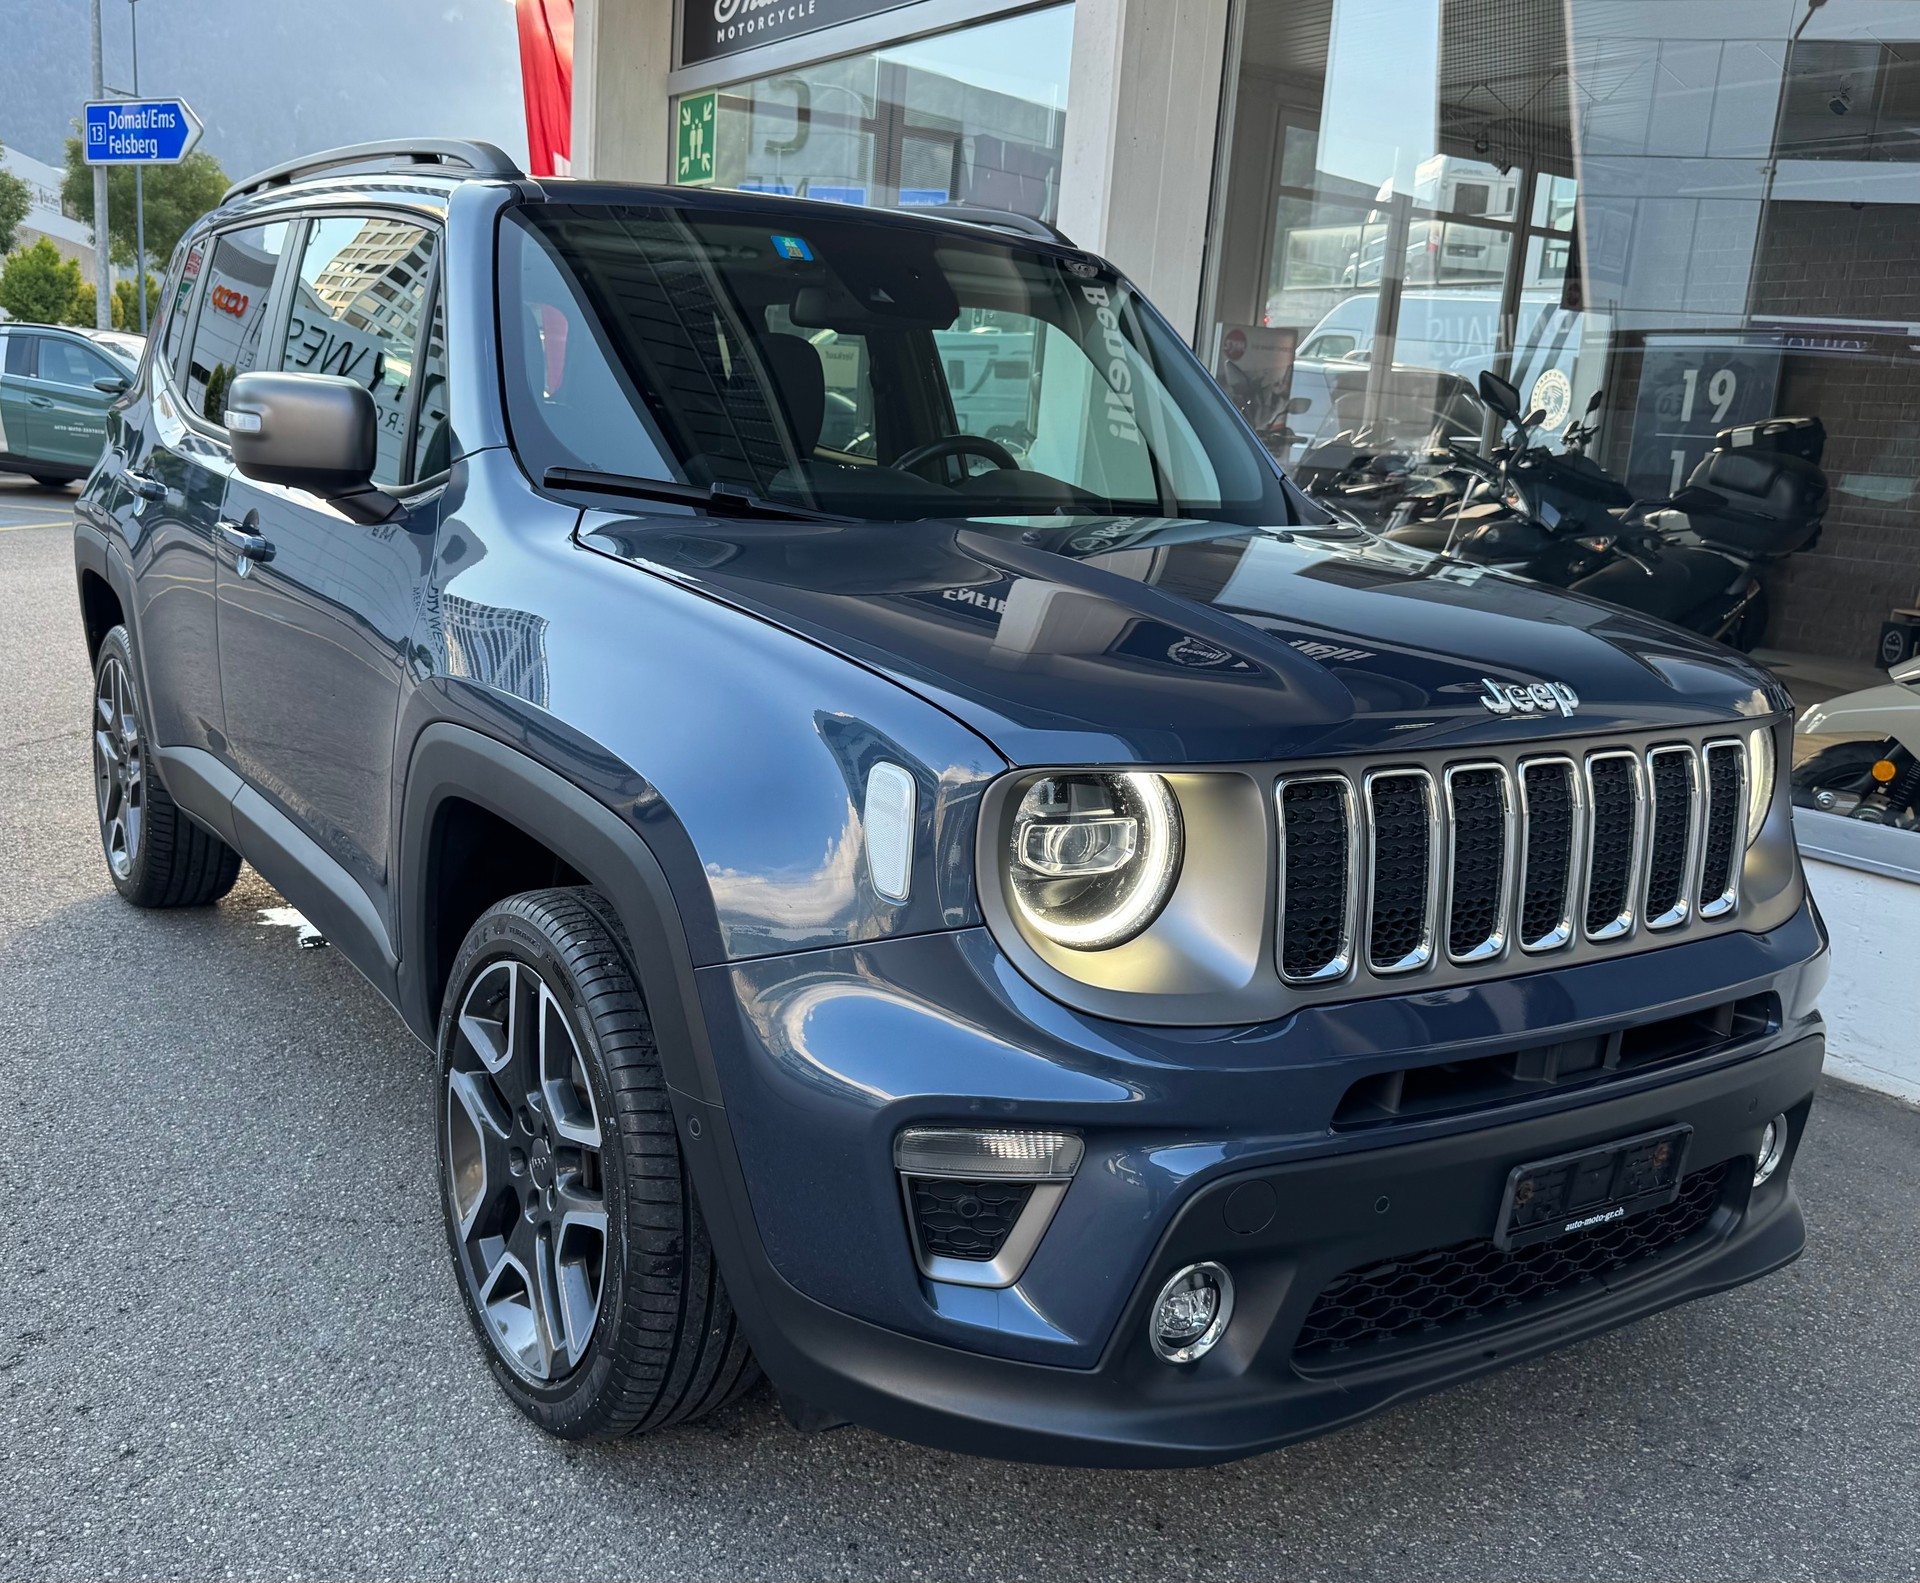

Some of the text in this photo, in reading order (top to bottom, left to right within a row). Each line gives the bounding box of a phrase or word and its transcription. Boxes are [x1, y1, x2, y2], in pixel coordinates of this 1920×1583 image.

[717, 0, 815, 43] MOTORCYCLE
[108, 109, 176, 130] Domat/Ems
[91, 126, 103, 142] 13
[109, 133, 158, 158] Felsberg
[1681, 369, 1737, 424] 19
[1480, 678, 1579, 718] Jeep
[1565, 1206, 1625, 1231] auto-moto-gr.ch
